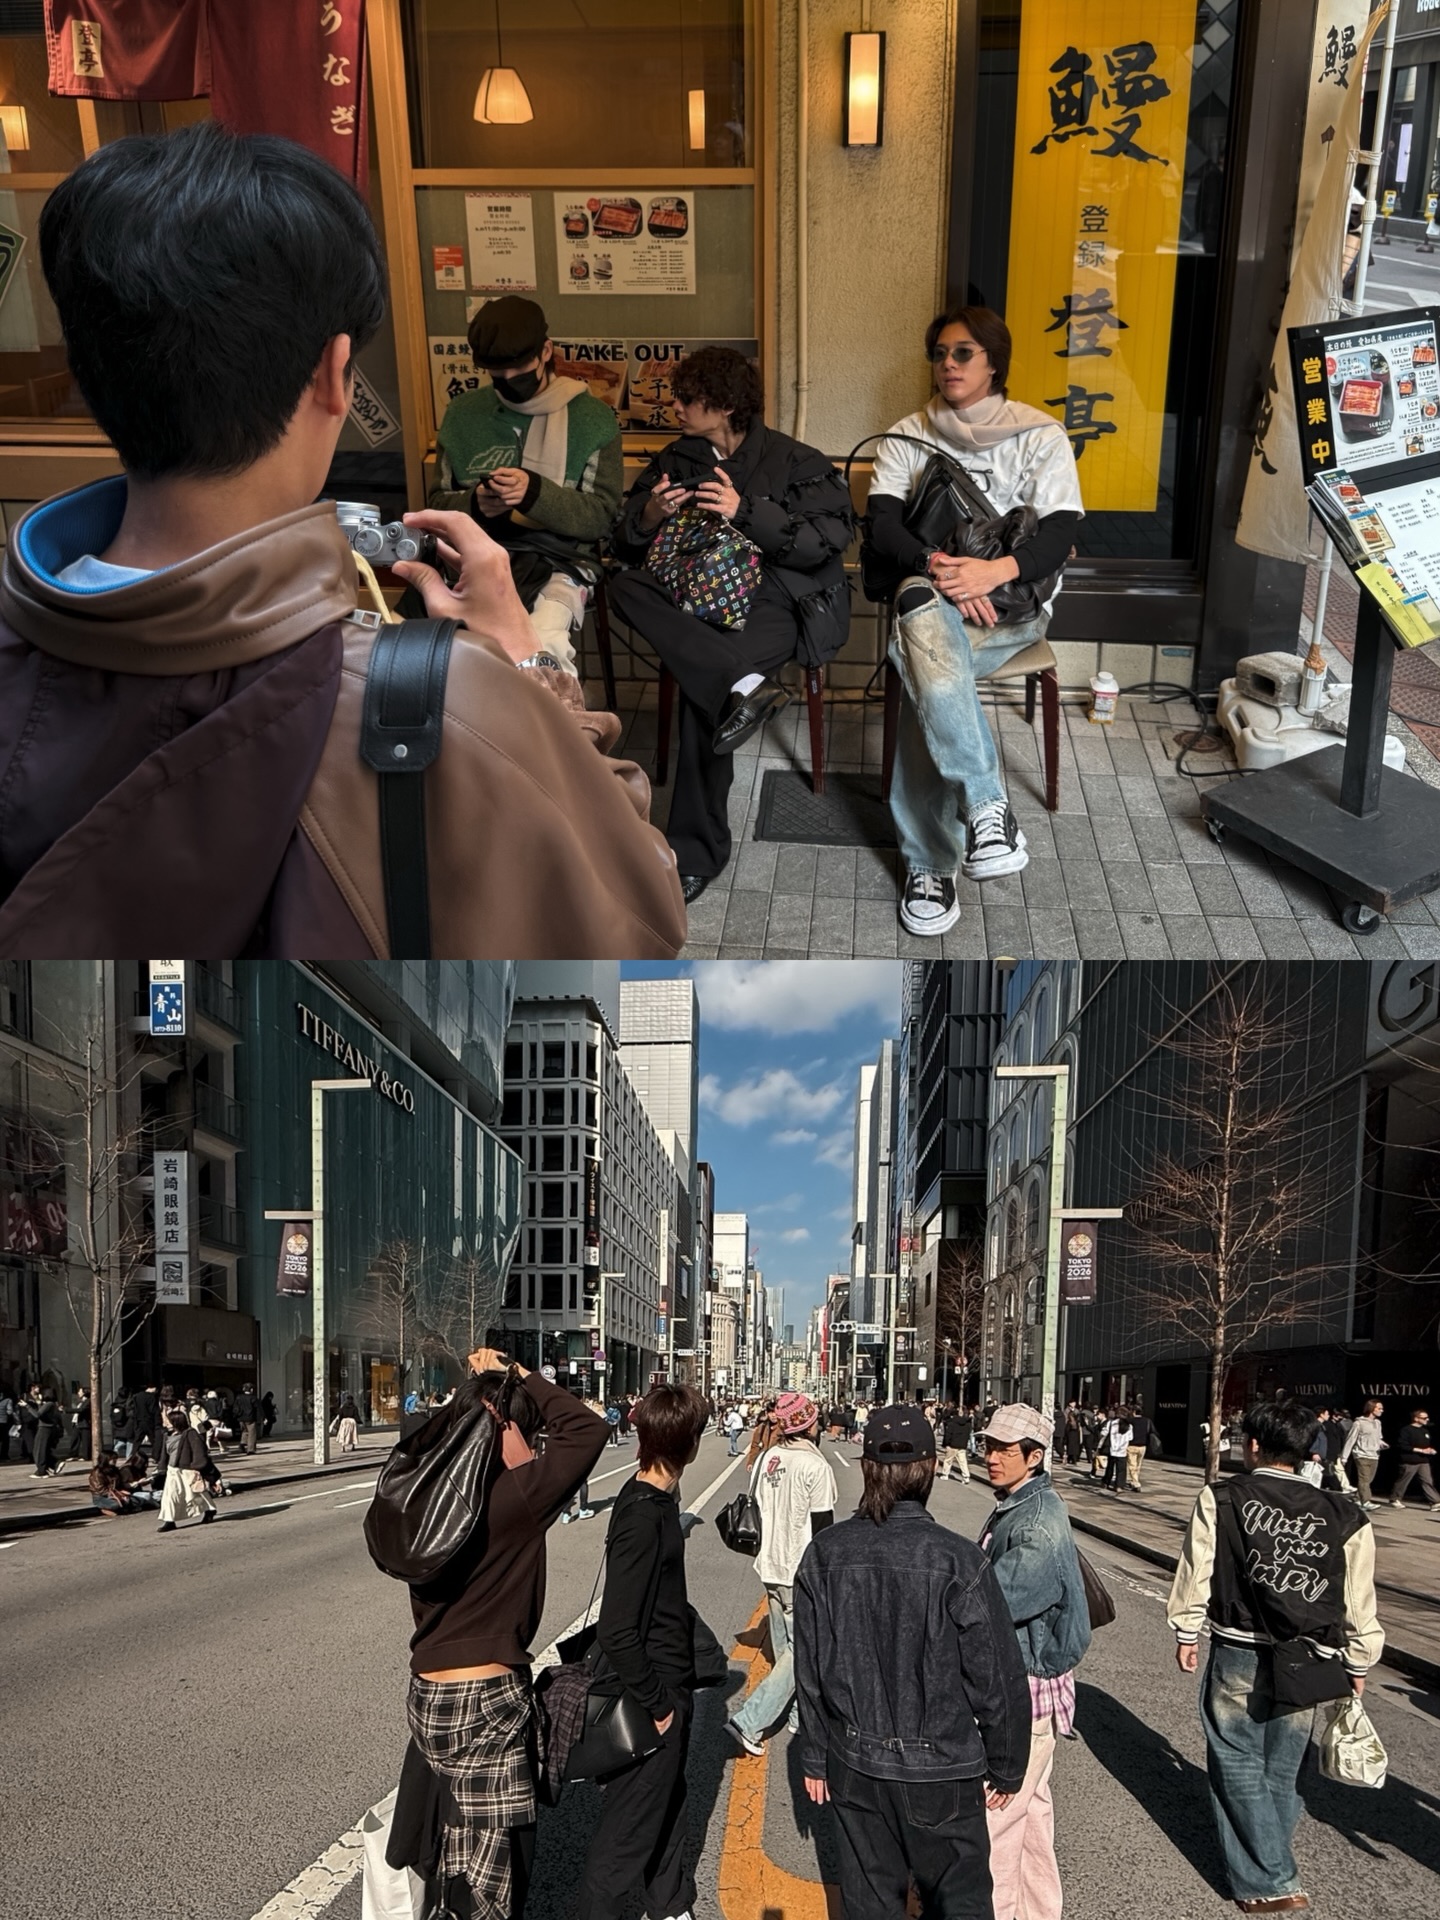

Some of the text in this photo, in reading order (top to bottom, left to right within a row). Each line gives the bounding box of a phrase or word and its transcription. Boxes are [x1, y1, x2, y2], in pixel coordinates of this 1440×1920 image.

[320, 1, 356, 135] うなぎ
[1029, 41, 1171, 166] 鰻
[1077, 204, 1110, 269] 登録
[560, 344, 684, 362] TAKE OUT
[1302, 356, 1331, 465] 営業中
[153, 993, 182, 1023] 青山
[163, 1158, 179, 1243] 岩崎眼鏡店
[284, 1263, 308, 1272] 2026
[285, 1254, 308, 1262] TOKYO
[1067, 1268, 1092, 1276] 2026
[1360, 1383, 1430, 1396] VALENTINO
[1273, 1537, 1329, 1561] you
